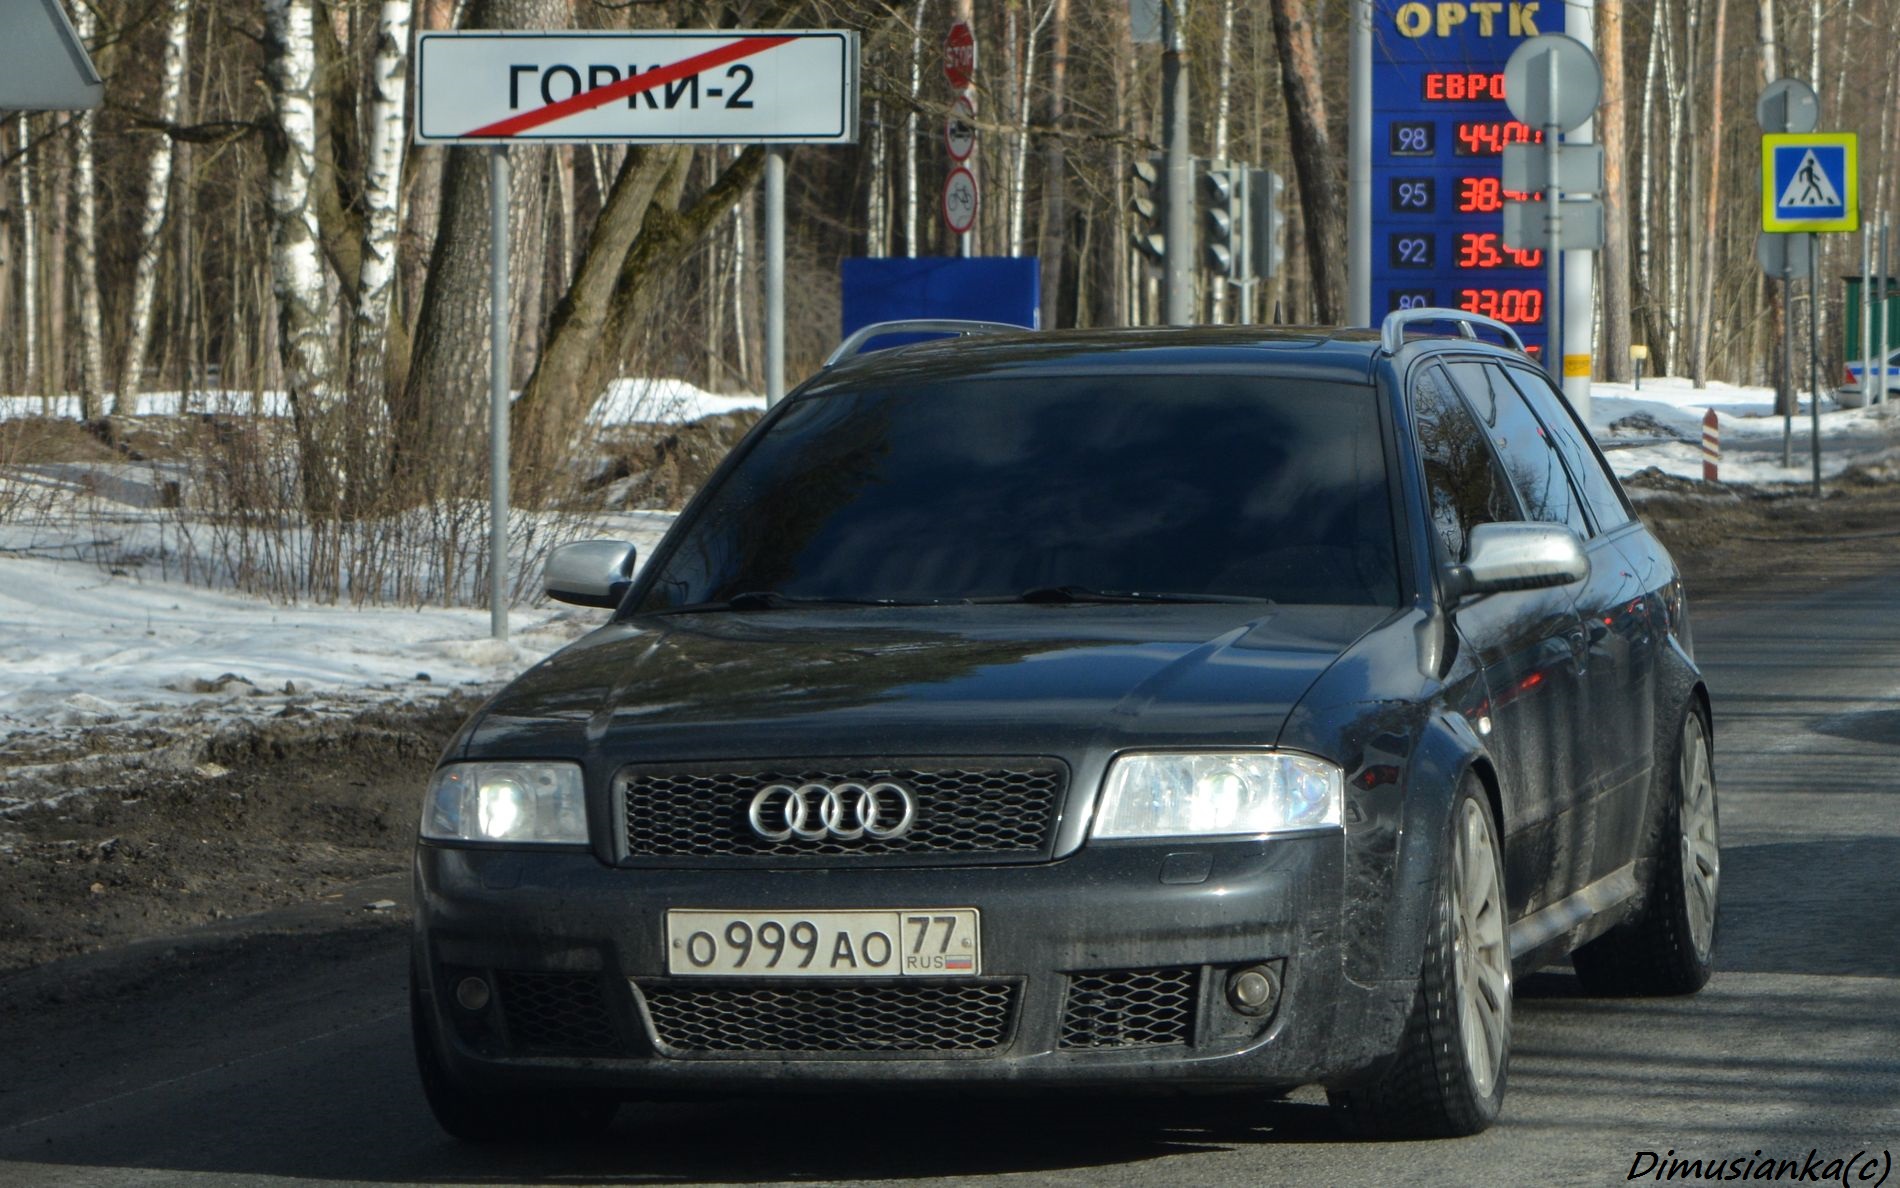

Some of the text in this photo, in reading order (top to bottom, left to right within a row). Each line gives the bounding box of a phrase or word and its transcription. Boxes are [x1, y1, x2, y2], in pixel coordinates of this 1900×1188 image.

[1396, 2, 1540, 38] ОРТК
[509, 63, 754, 110] ГОРКИ-2
[1399, 128, 1427, 150] 98
[1399, 183, 1427, 206] 95
[1399, 239, 1427, 263] 92
[907, 916, 957, 954] 77
[907, 956, 944, 969] RUS
